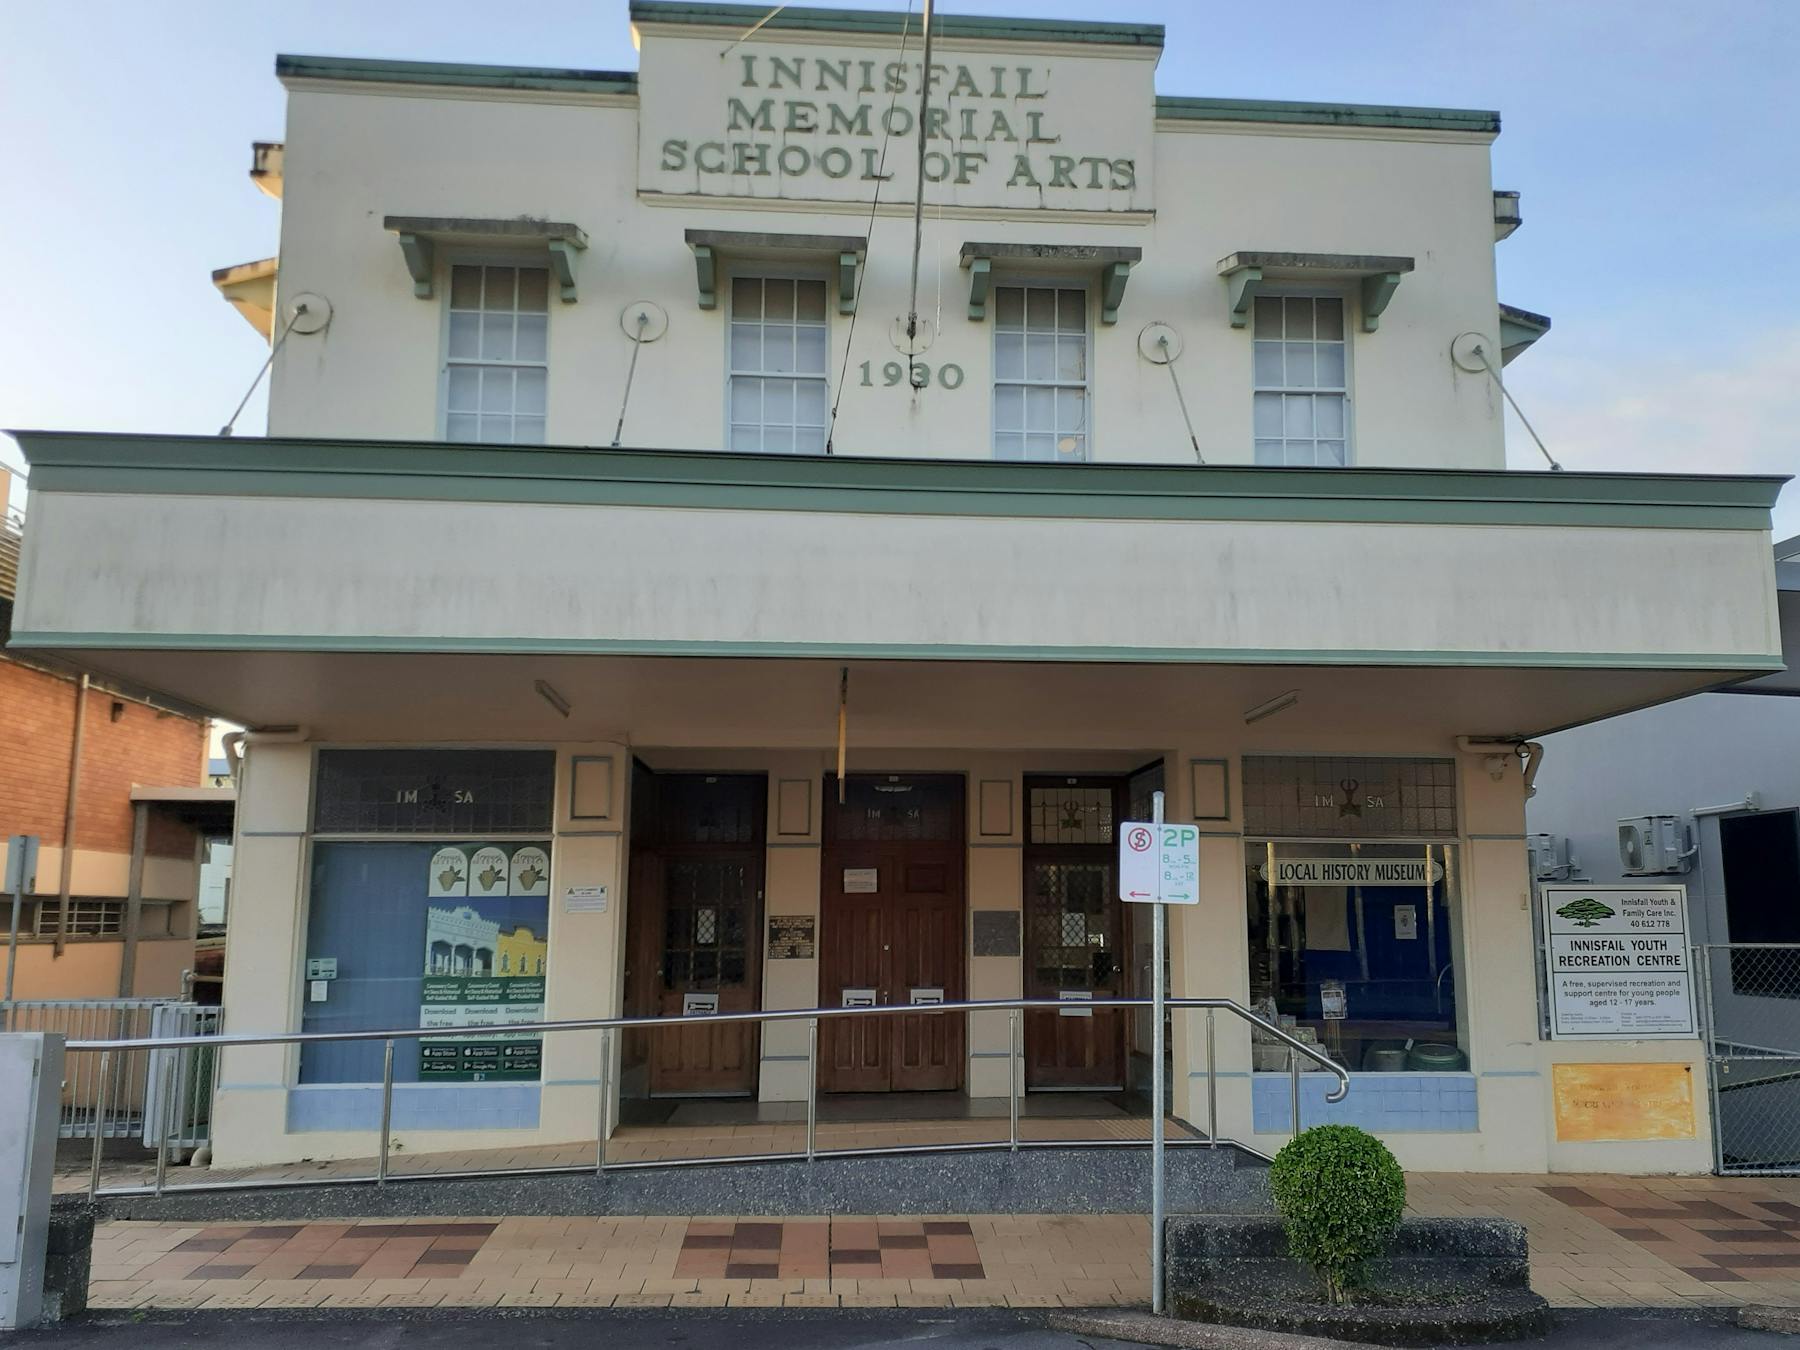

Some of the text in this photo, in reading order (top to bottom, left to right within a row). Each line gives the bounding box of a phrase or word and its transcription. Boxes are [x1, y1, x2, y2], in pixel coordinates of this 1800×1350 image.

[741, 55, 1048, 99] INNISFAIL
[728, 98, 1061, 143] MEMORIAL
[661, 139, 1136, 191] SCHOOL OF ARTS
[859, 360, 965, 390] 1930
[1163, 829, 1196, 847] 2P
[1279, 863, 1427, 881] LOCAL HISTORY MUSEUM
[1621, 898, 1648, 906] Innisfail
[1649, 898, 1669, 906] Youth
[1622, 909, 1676, 918] Family Care Inc.
[1570, 940, 1668, 951] INNISFAIL YOUTH
[1559, 955, 1681, 967] RECREATION CENTRE
[1569, 980, 1586, 988] free,
[1588, 980, 1628, 988] supervised
[1564, 990, 1593, 998] support
[1655, 990, 1680, 998] people
[1589, 999, 1608, 1007] aged
[1634, 999, 1656, 1007] years.
